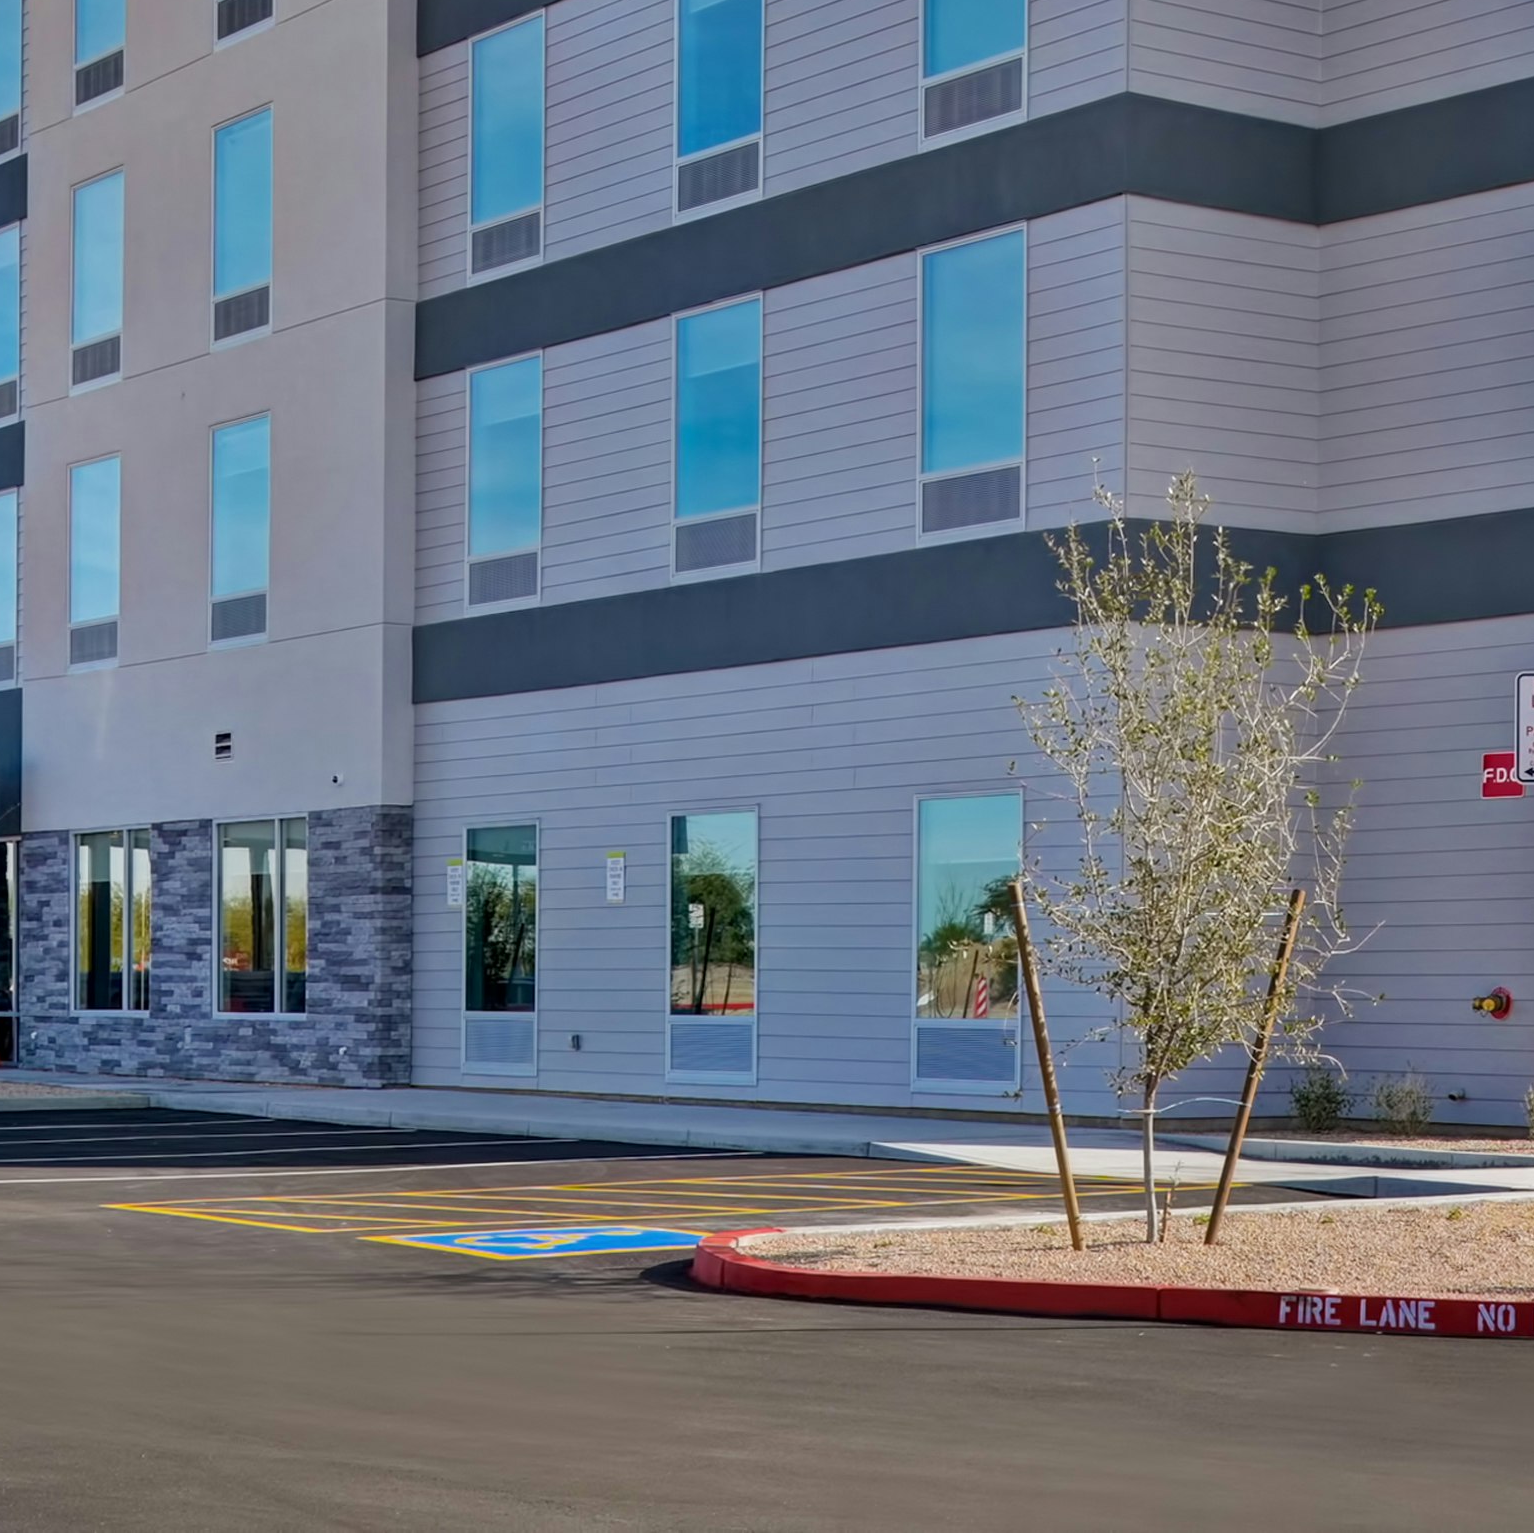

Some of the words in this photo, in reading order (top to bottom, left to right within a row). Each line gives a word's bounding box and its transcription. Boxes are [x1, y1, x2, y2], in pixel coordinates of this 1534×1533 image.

[1278, 1295, 1342, 1326] FIRE
[1359, 1299, 1436, 1330] LANE
[1477, 1303, 1516, 1332] NO
